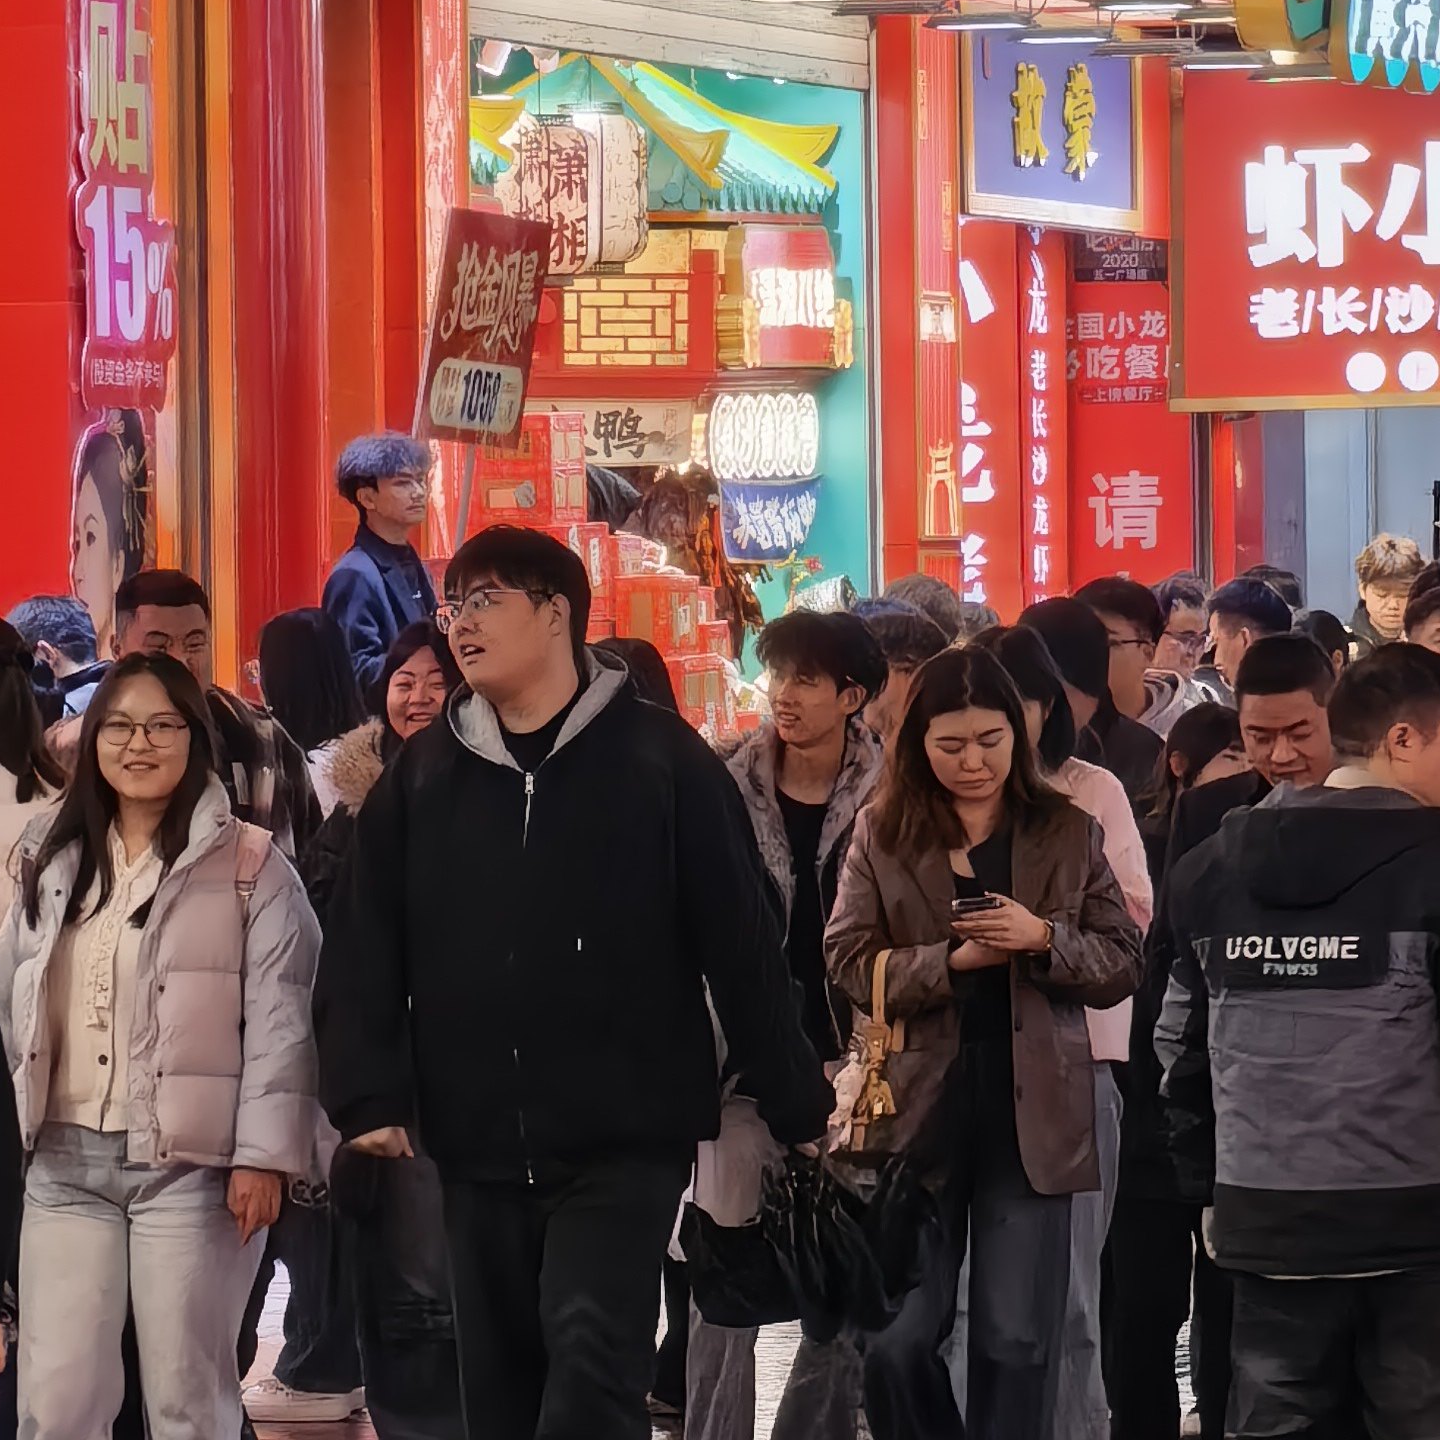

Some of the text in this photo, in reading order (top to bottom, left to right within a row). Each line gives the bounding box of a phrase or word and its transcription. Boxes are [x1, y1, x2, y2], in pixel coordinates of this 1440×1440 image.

[85, 184, 173, 342] 15%
[439, 240, 540, 354] 抢金风暴
[1101, 253, 1139, 269] 2020
[1067, 344, 1170, 381] 吃餐
[584, 406, 647, 460] 鸭
[1030, 349, 1051, 604] 老长沙龙虾
[1088, 470, 1163, 552] 请
